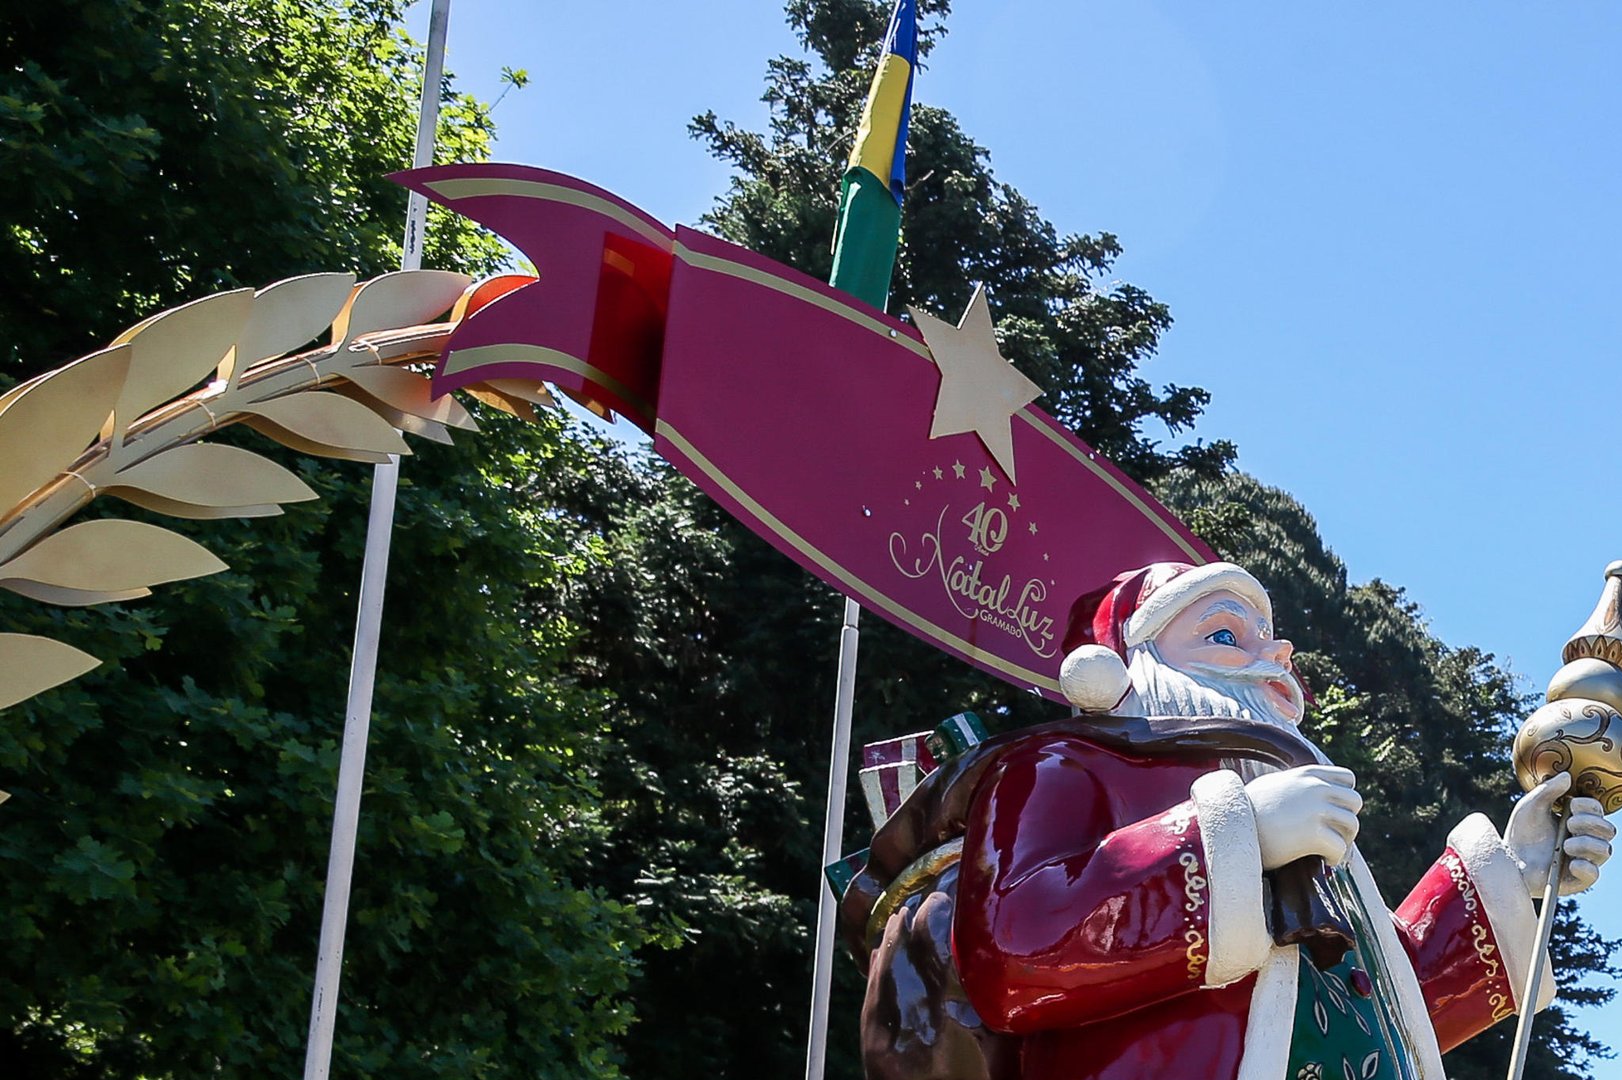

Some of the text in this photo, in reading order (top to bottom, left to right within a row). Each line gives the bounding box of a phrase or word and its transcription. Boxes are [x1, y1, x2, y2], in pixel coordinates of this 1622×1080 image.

[962, 501, 1008, 552] 40
[889, 504, 1057, 658] Natal Luz
[979, 609, 1022, 638] GRAMADO
